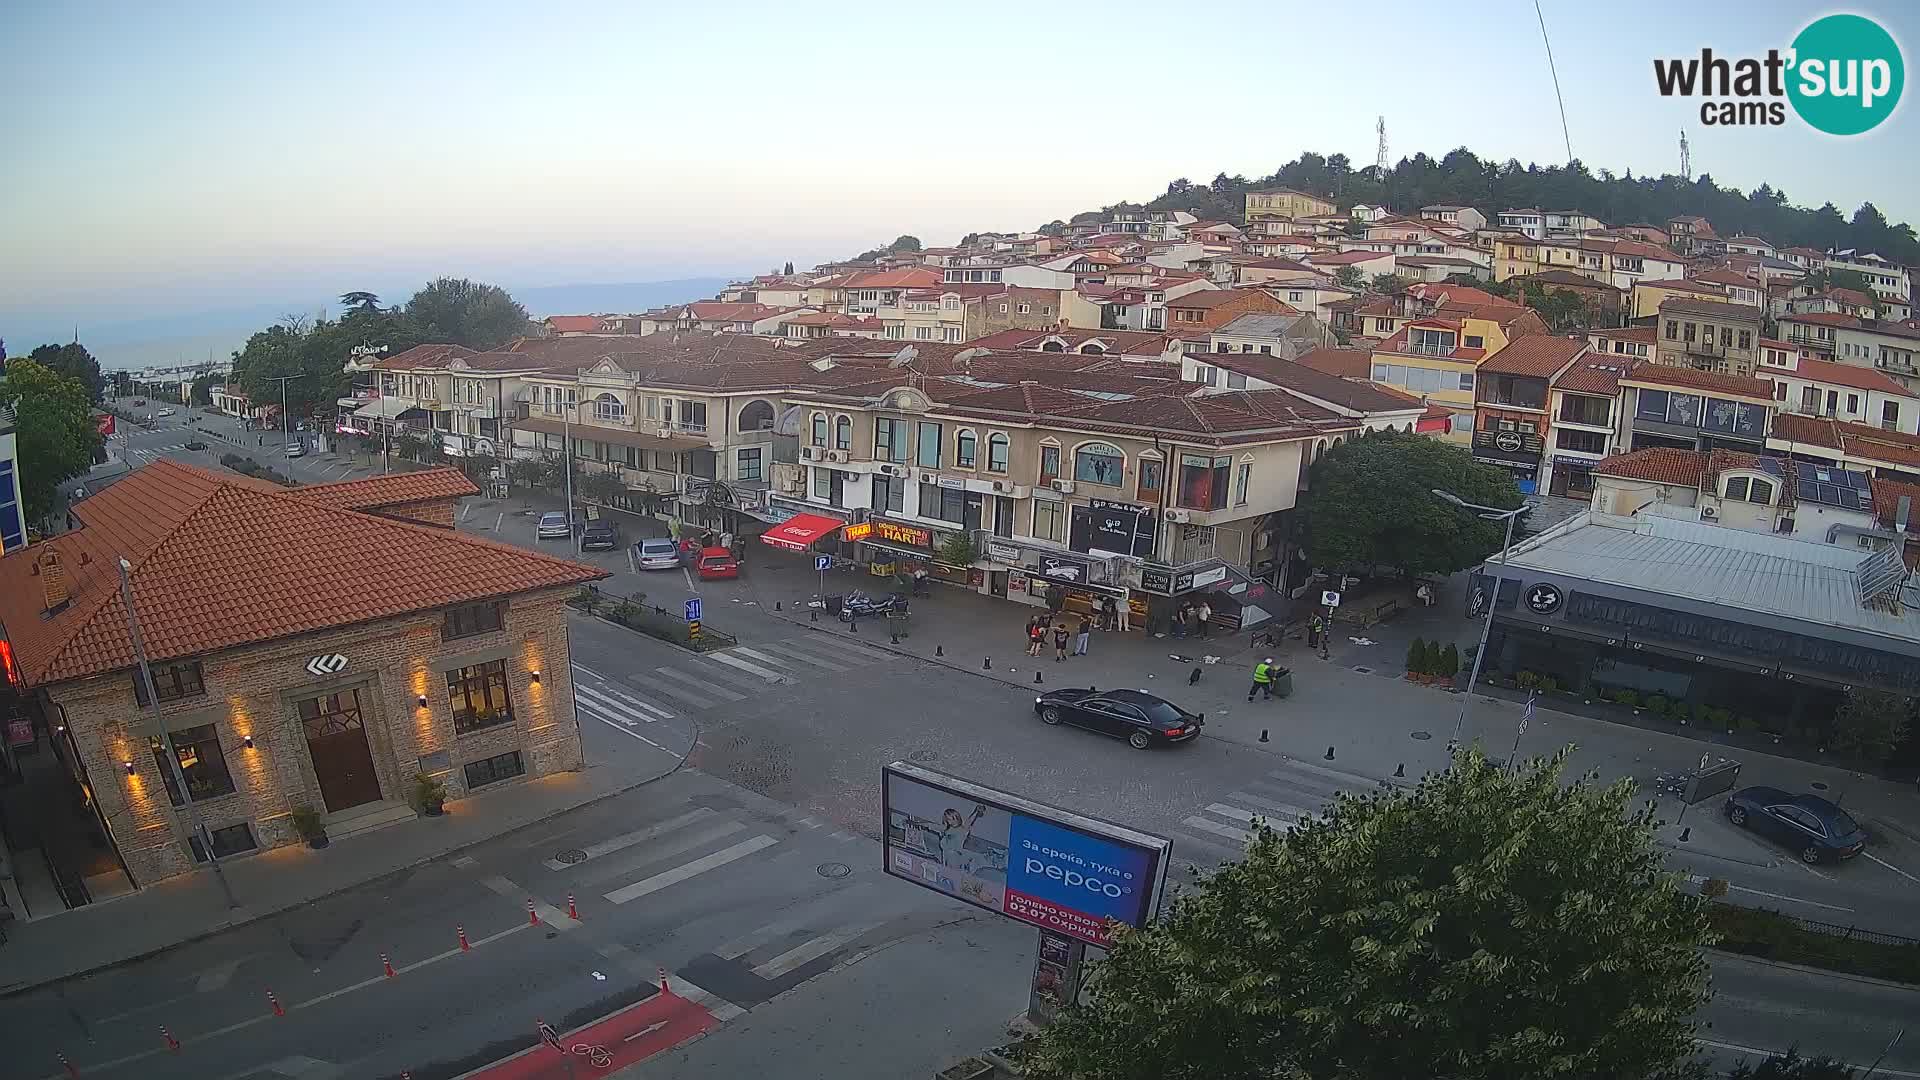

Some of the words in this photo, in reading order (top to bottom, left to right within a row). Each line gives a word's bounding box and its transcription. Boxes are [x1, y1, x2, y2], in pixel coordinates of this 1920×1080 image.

[884, 529, 916, 545] HARI
[1022, 839, 1039, 851] За
[1090, 861, 1120, 876] тука
[1123, 872, 1132, 880] е
[1009, 902, 1047, 920] 02.07
[1049, 915, 1096, 939] Охрид
